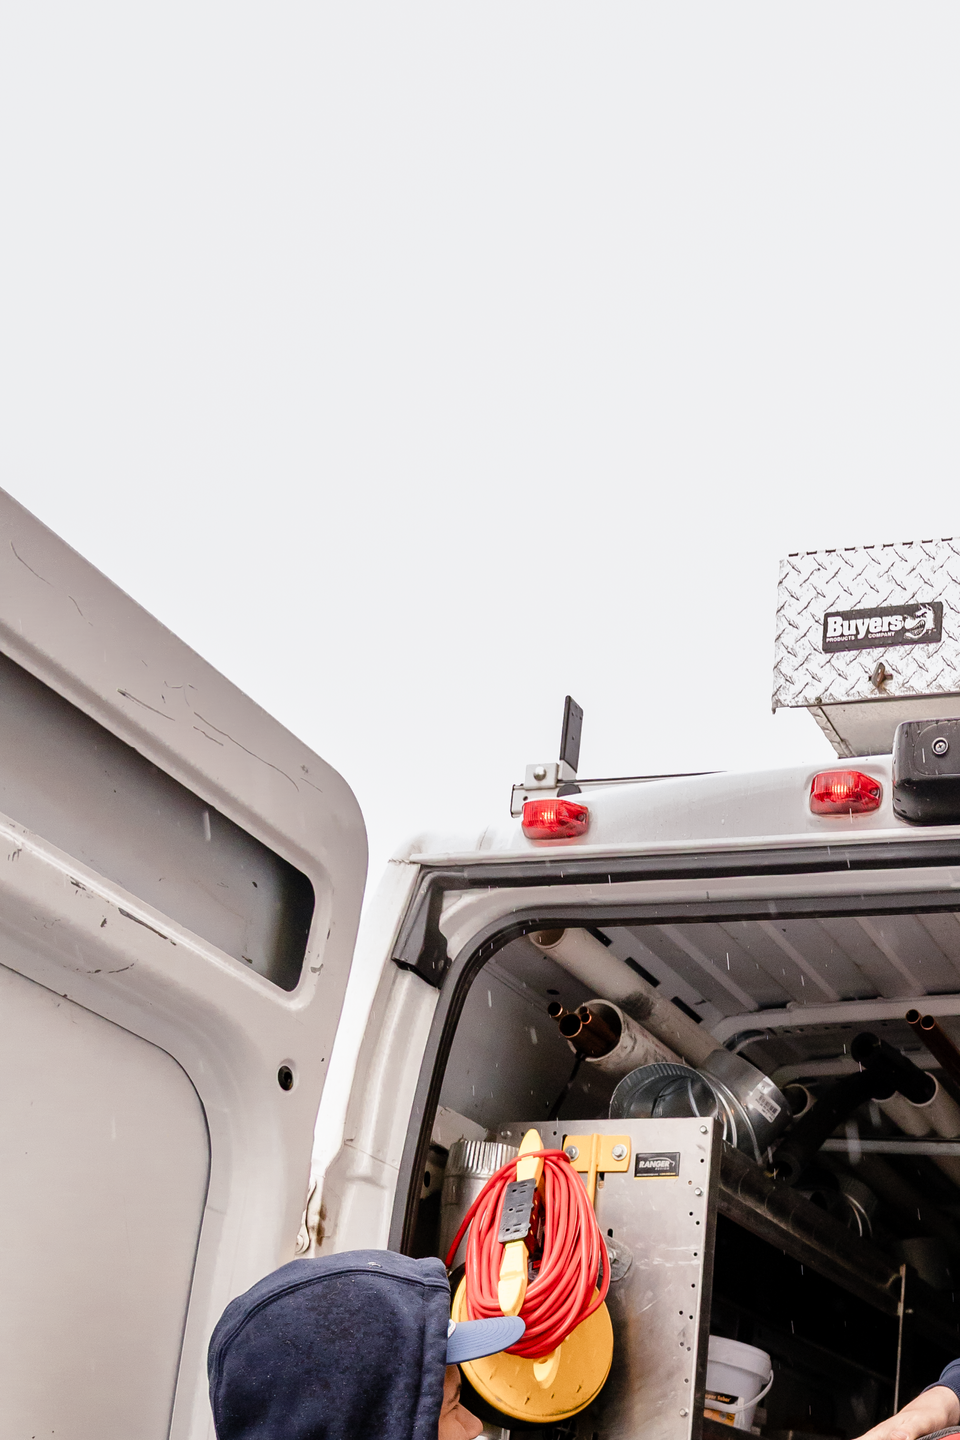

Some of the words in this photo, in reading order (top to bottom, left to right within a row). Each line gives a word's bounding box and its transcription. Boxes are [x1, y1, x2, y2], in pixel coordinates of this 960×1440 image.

[827, 615, 904, 640] Buyers
[826, 635, 855, 643] PRODUCTS
[868, 631, 895, 639] COMPANY
[639, 1160, 671, 1169] RANGER
